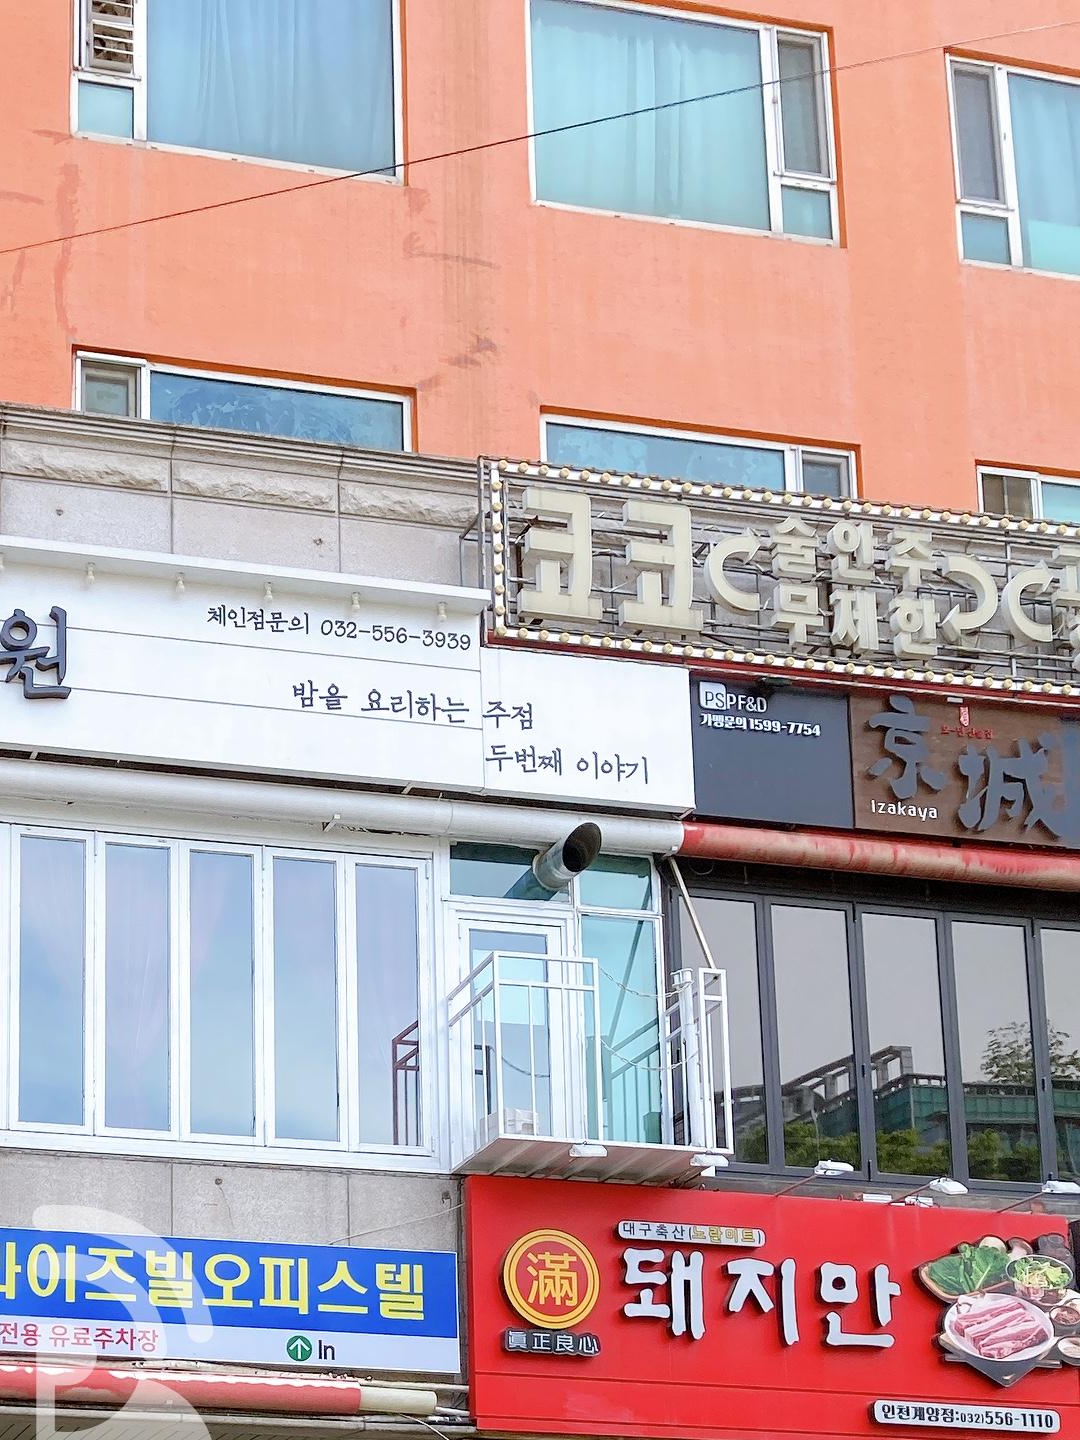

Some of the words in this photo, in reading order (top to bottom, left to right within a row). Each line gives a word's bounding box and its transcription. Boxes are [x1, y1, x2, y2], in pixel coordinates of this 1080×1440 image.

[517, 486, 704, 635] 코코
[770, 514, 938, 594] 술안주
[207, 604, 310, 635] 체인점문의
[320, 618, 472, 652] 032-556-3939
[771, 583, 940, 661] 무제한
[292, 680, 349, 711] 밤을
[360, 688, 471, 725] 요리하는
[482, 701, 535, 731] 주점
[700, 713, 748, 730] 가맹문의
[748, 717, 821, 737] 1599-7754
[485, 745, 563, 777] 두번째
[575, 751, 650, 785] 이야기
[871, 799, 939, 822] Izakaya
[526, 1252, 578, 1308] 滿
[623, 1246, 901, 1349] 돼지만
[49, 1326, 159, 1352] 유료주차장
[317, 1339, 336, 1361] In
